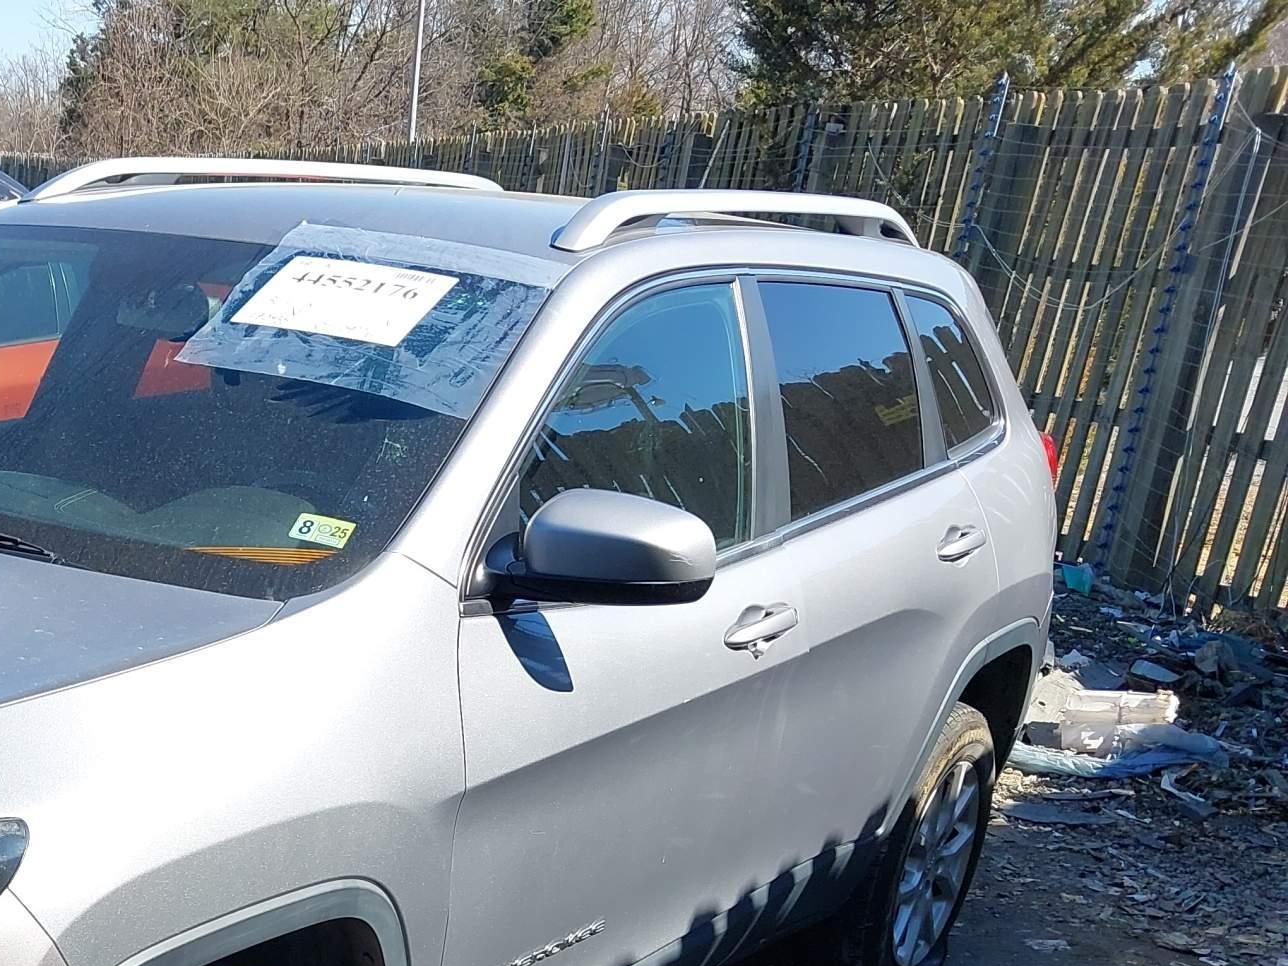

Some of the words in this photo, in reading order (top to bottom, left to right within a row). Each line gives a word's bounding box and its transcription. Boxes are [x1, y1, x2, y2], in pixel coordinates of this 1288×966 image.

[291, 271, 420, 301] 44552176
[298, 519, 315, 535] 8
[329, 526, 350, 539] 25
